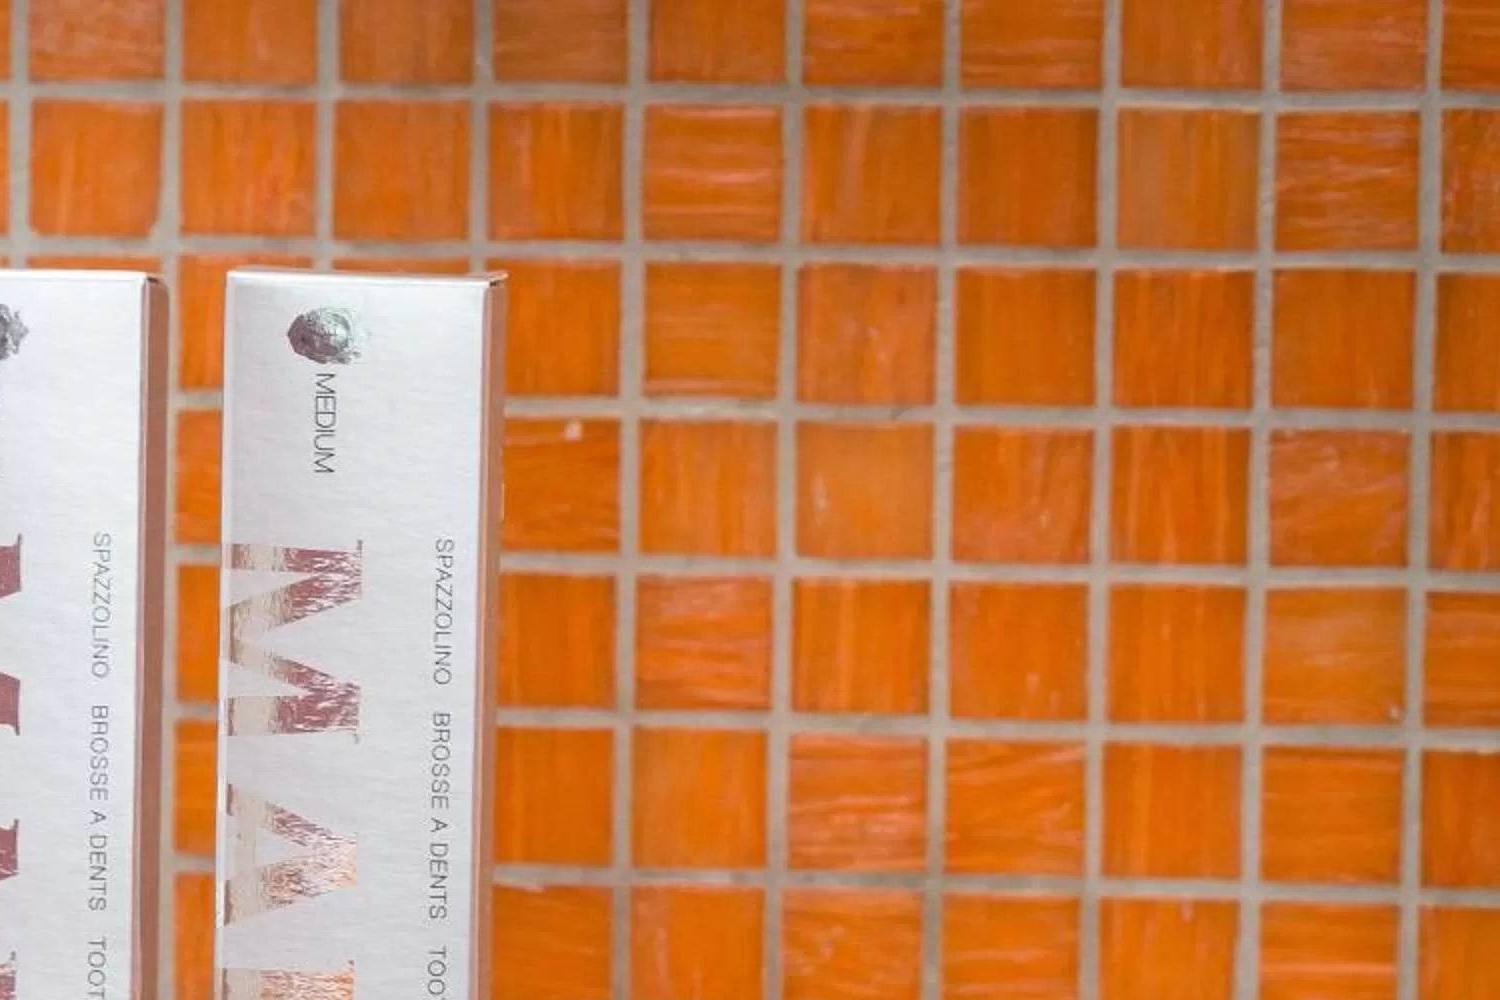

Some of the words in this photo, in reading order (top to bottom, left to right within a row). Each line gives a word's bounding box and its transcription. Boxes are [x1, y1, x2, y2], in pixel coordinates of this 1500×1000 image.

[314, 372, 336, 475] MEDIUM
[91, 532, 111, 680] SPAZZOLINO
[433, 538, 454, 686] SPAZZOLINO
[89, 705, 109, 802] BROSSE
[431, 712, 451, 809] BROSSE
[90, 809, 107, 825] A
[431, 817, 448, 832] A
[87, 834, 107, 912] DENTS
[429, 843, 449, 920] DENTS
